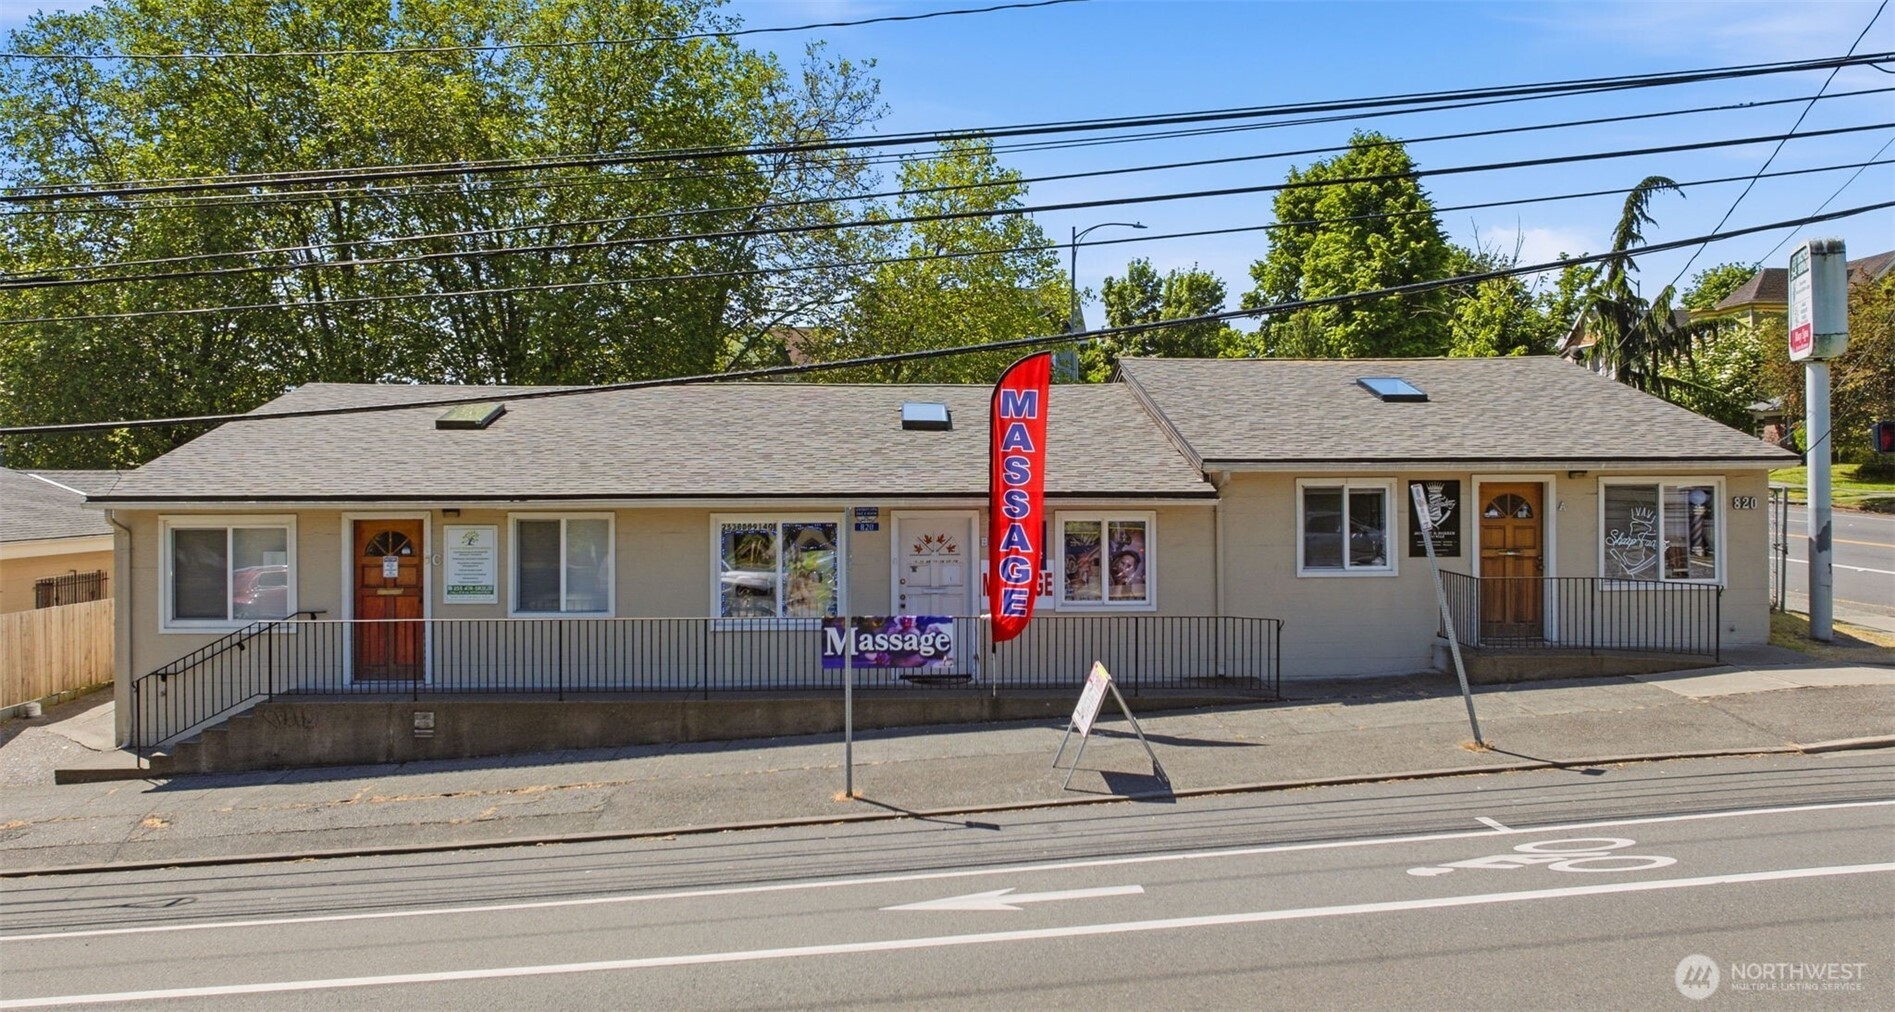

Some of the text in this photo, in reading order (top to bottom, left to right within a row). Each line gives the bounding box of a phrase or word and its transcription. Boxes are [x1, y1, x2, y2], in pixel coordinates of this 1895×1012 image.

[1000, 389, 1039, 618] MASSAGE
[1732, 496, 1758, 510] 820
[824, 627, 951, 657] Massage
